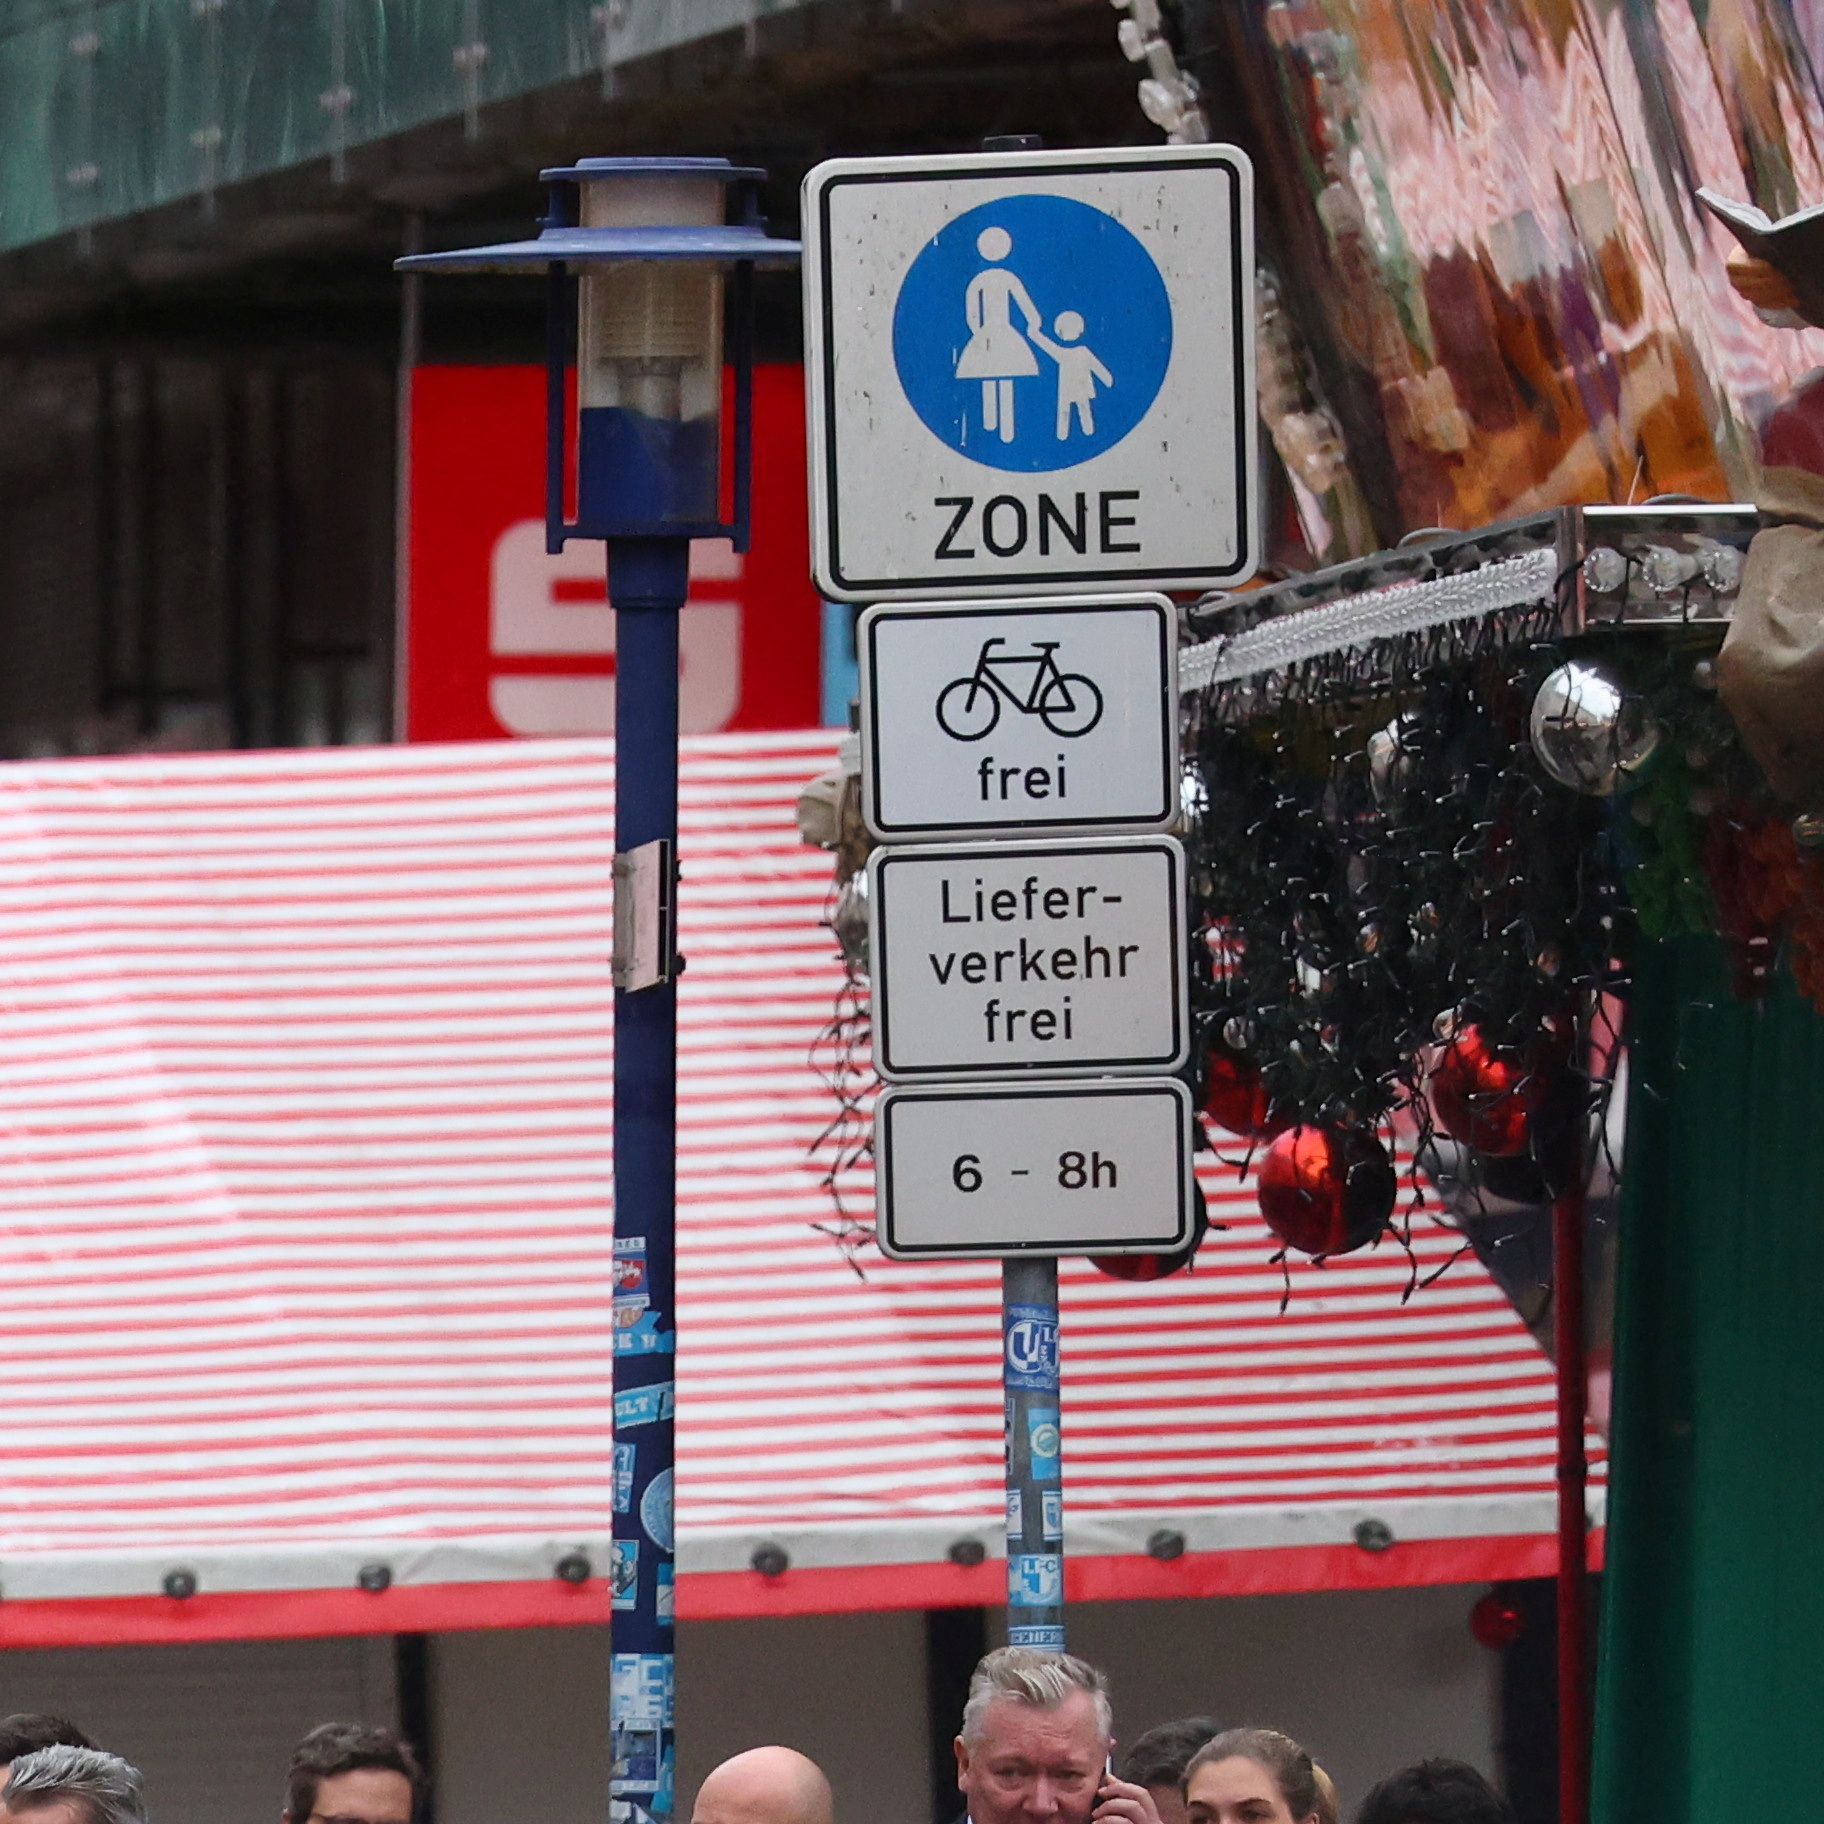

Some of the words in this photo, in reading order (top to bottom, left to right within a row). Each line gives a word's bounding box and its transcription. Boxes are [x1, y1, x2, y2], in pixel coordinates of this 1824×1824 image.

[933, 489, 1142, 560] ZONE
[977, 753, 1067, 801] frei
[940, 875, 1123, 923] Liefer-
[928, 934, 1140, 985] verkehr
[983, 995, 1073, 1043] frei
[952, 1153, 984, 1194] 6
[1057, 1150, 1118, 1190] 8h
